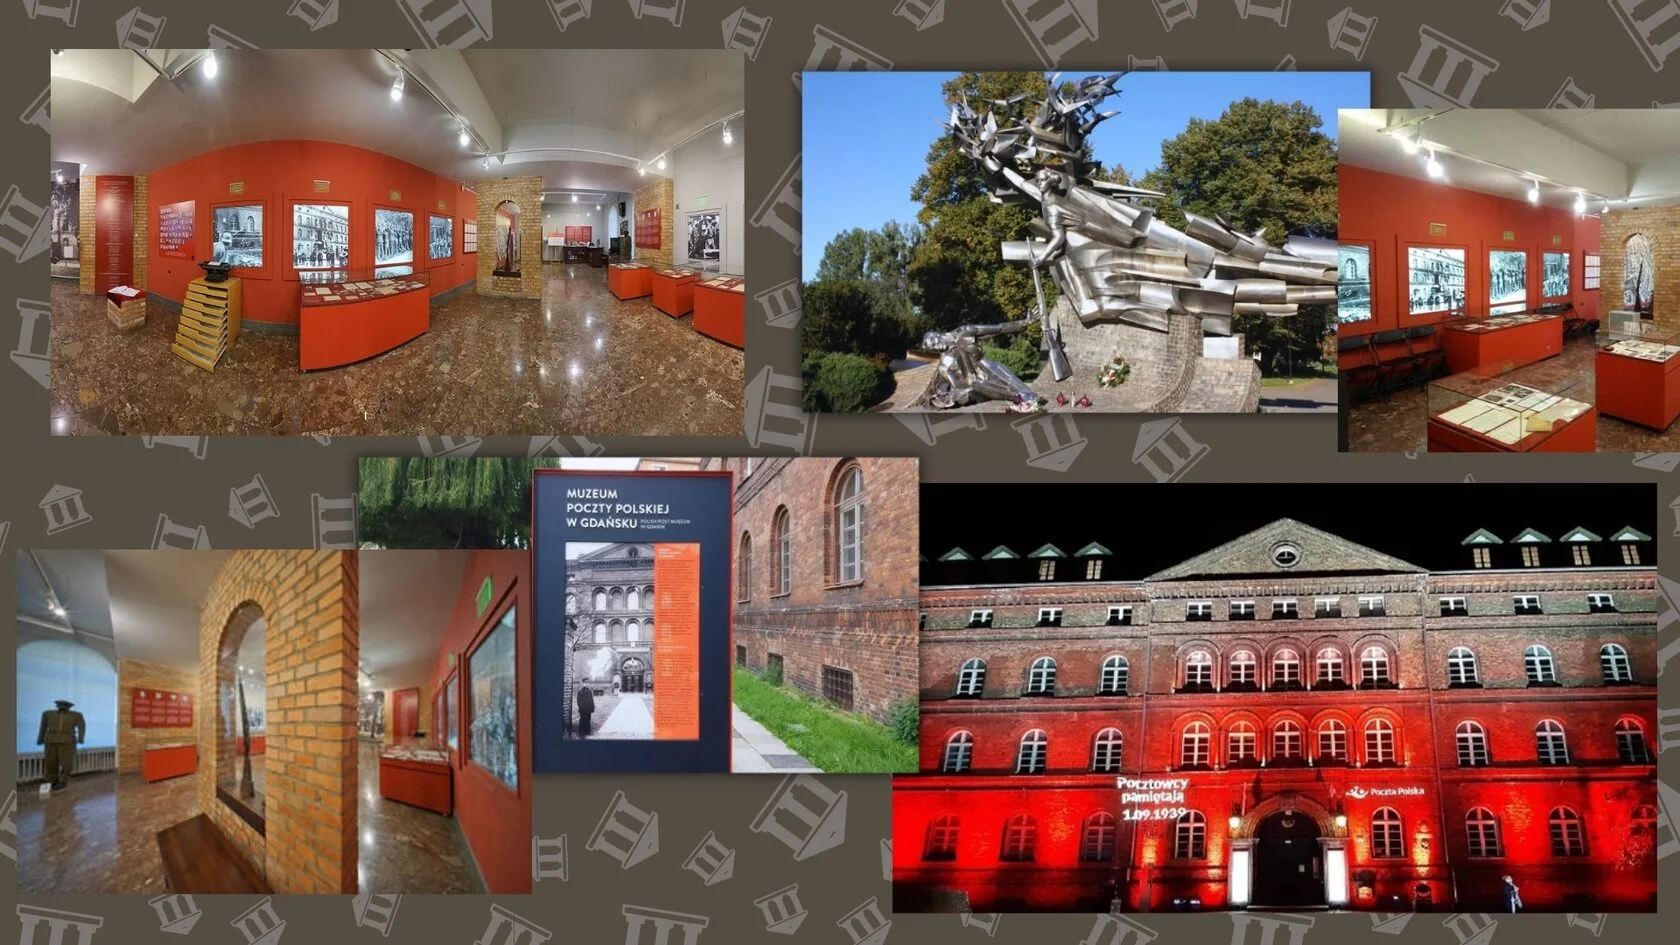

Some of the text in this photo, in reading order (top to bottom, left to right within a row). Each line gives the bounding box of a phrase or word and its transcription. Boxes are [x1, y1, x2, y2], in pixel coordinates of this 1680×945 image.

[566, 488, 618, 499] MUZEUM
[566, 503, 670, 514] POCZTY POLSKIEJ
[566, 515, 638, 529] W GDAŃSKU
[1116, 776, 1190, 790] Pocztowcy
[1121, 789, 1185, 804] pamiętają
[1370, 786, 1425, 796] Poczta Polska
[1122, 807, 1187, 820] 1.09.1939
